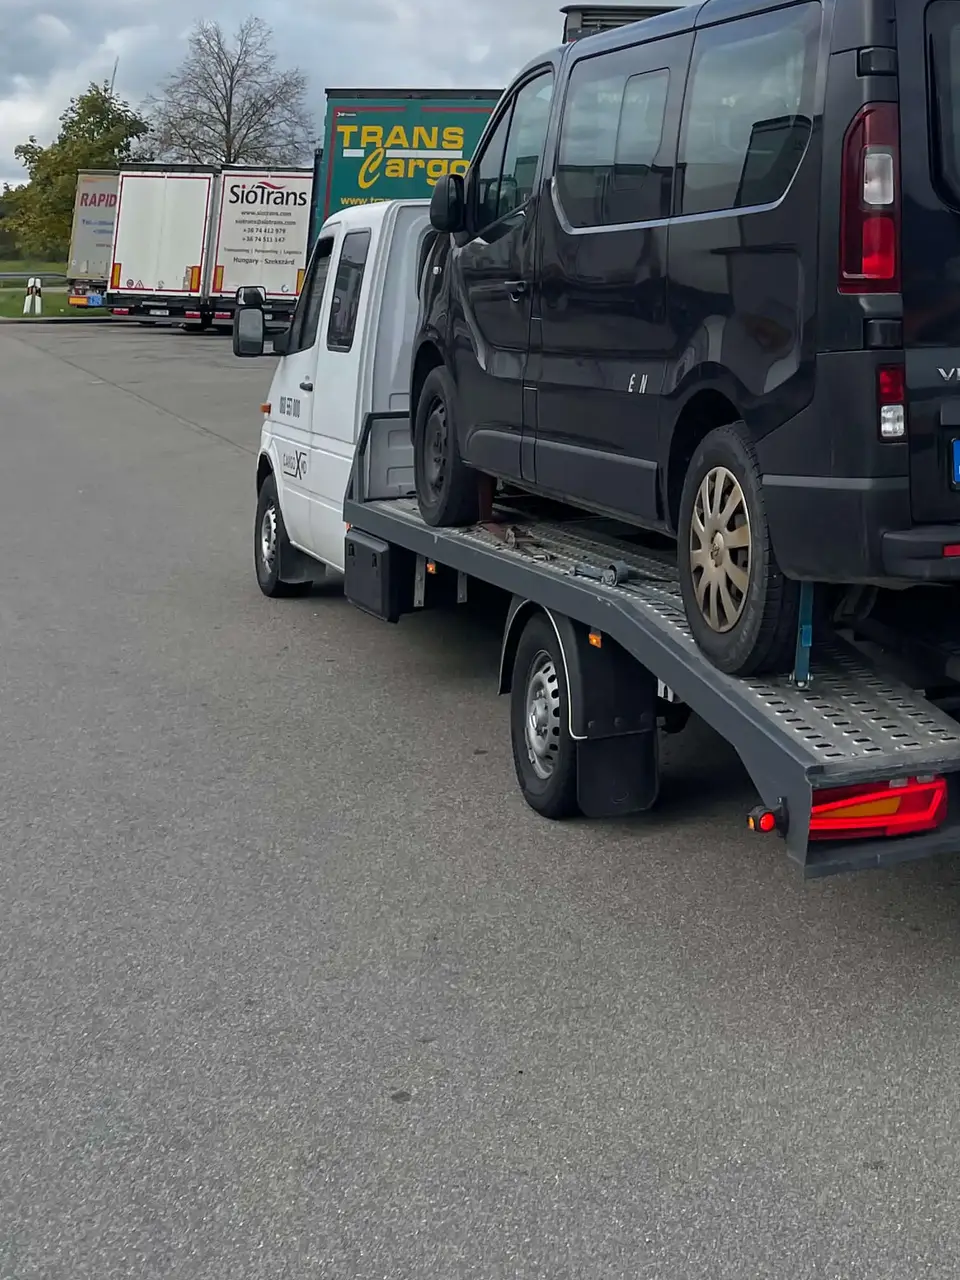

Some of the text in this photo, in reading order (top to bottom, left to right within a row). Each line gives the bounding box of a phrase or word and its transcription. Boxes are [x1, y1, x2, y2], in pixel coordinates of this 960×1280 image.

[337, 125, 464, 150] TRANS
[358, 147, 471, 189] Cargo
[229, 184, 307, 206] SióTrans
